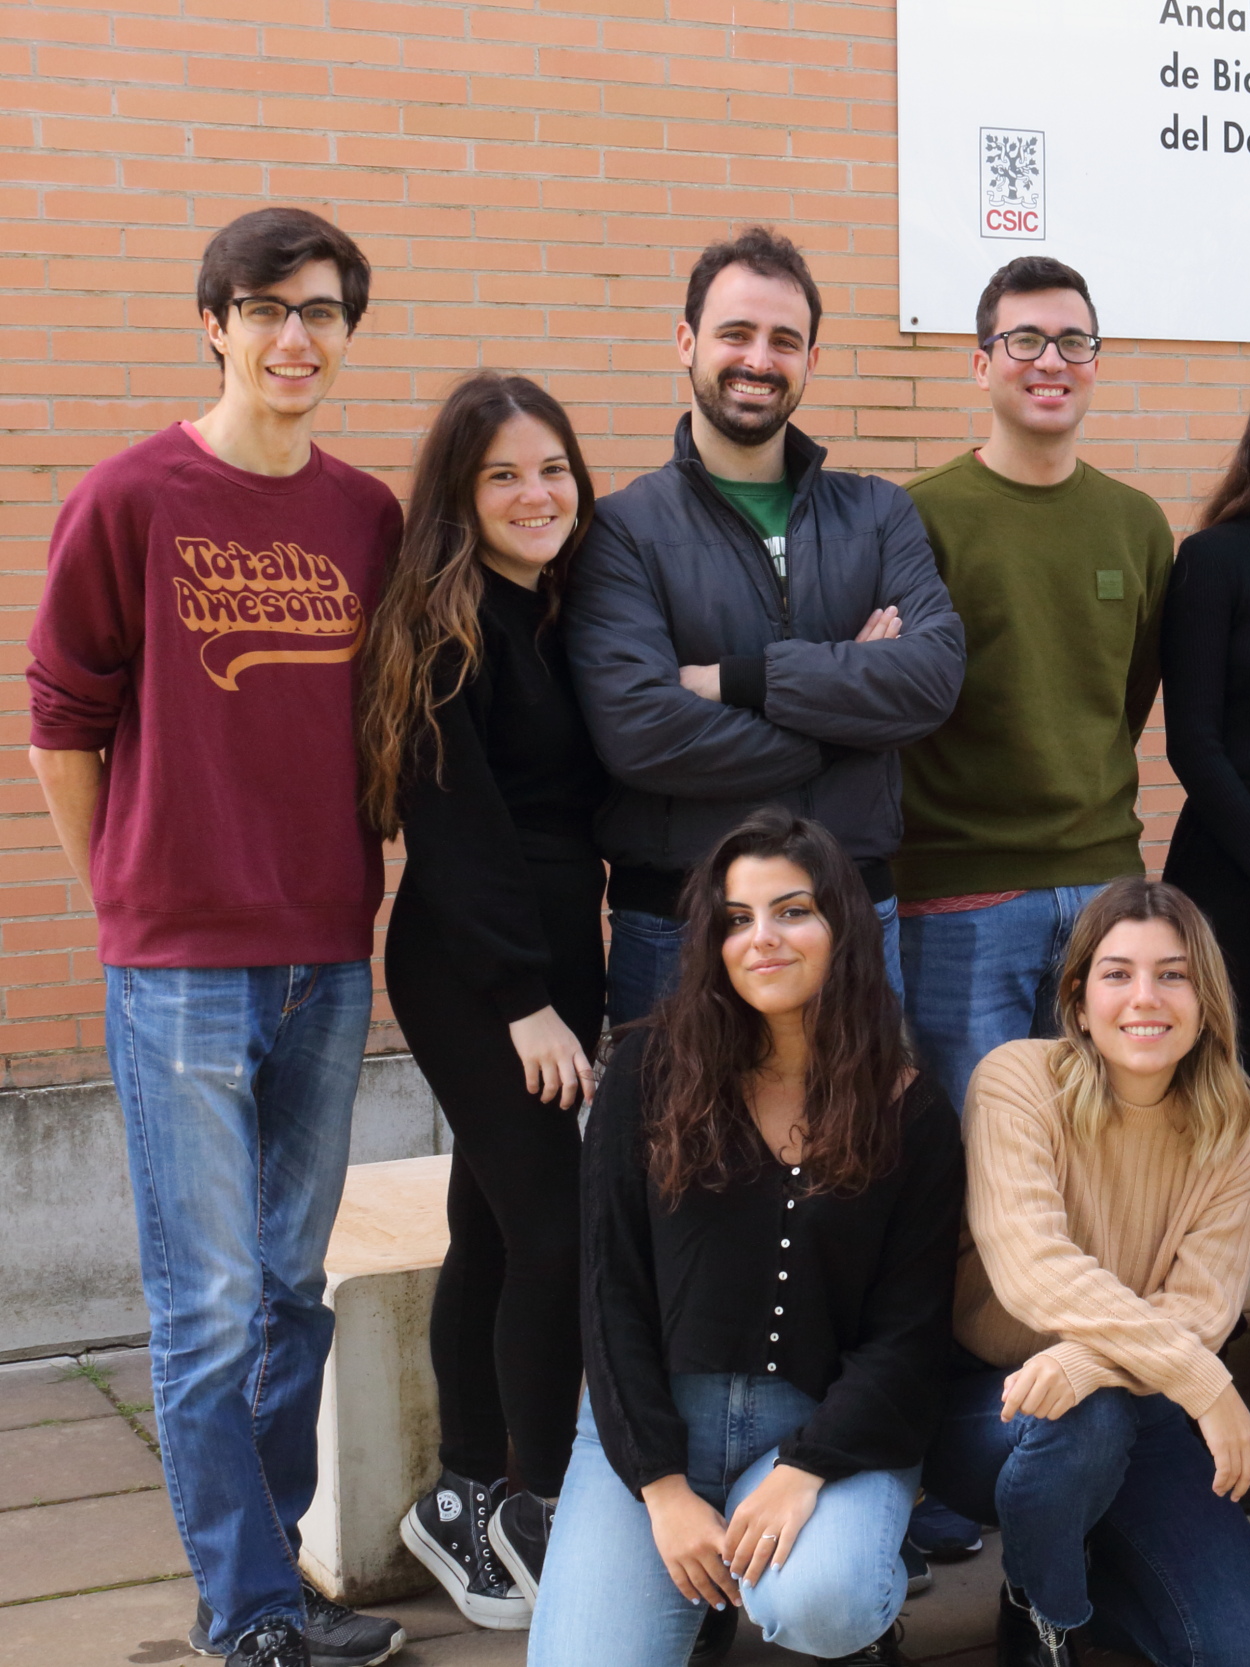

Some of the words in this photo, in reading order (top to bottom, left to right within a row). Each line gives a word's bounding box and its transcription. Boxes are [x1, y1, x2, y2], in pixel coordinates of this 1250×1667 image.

[1160, 51, 1199, 89] de
[1160, 113, 1208, 151] del
[986, 209, 1039, 232] CSIC
[176, 537, 350, 592] Totally
[173, 577, 361, 633] Awesome
